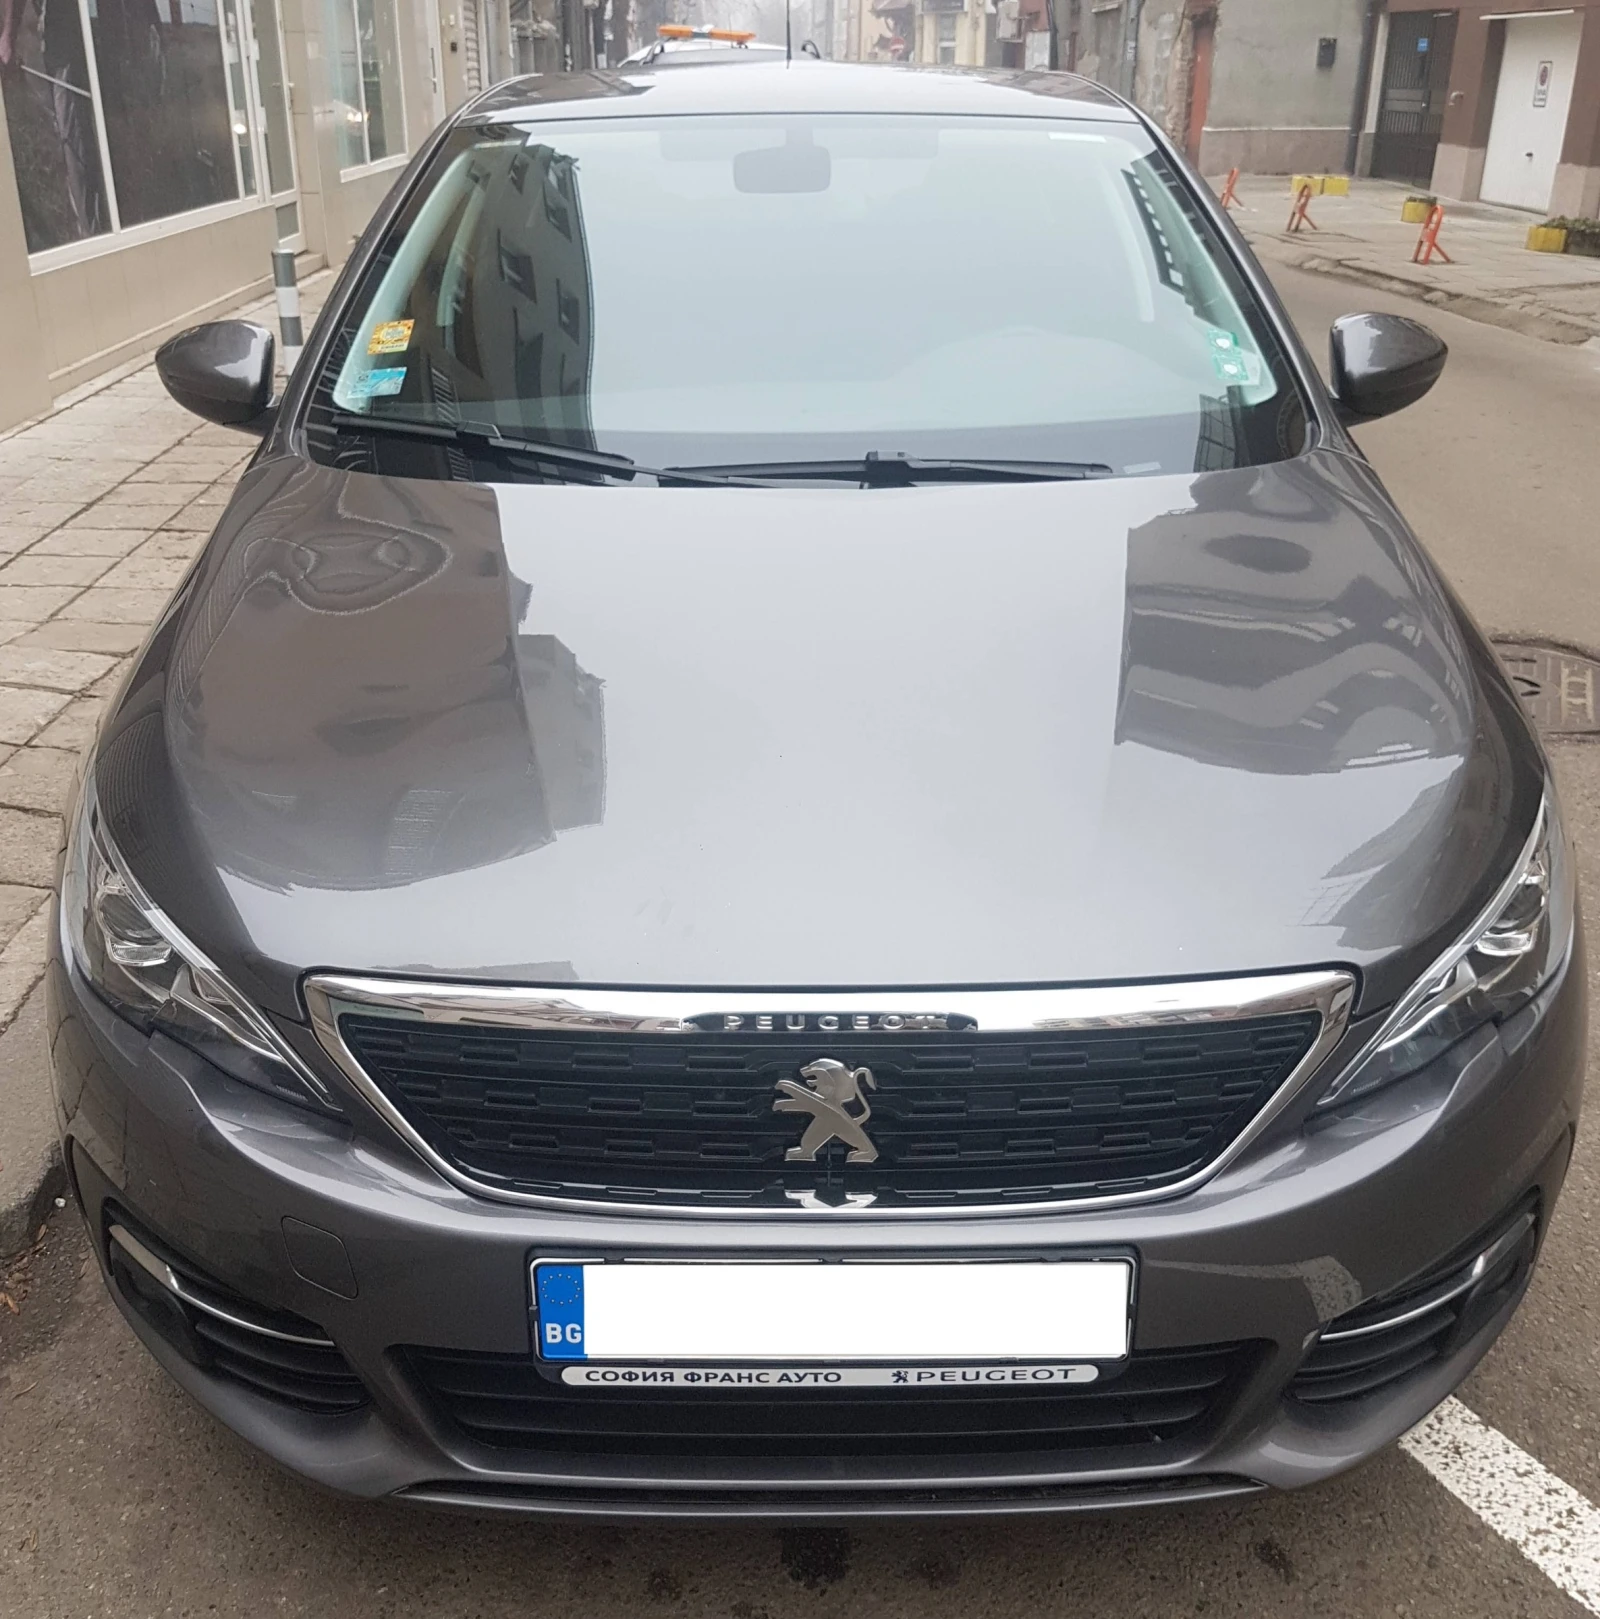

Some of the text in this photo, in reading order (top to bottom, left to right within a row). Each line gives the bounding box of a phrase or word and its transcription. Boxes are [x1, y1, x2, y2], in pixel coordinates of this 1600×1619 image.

[723, 1013, 939, 1031] PEUGEOT
[545, 1322, 583, 1344] BG
[584, 1370, 843, 1384] СОФИЯ ФРАНС АУТО
[916, 1368, 1077, 1383] PEUGEOT
